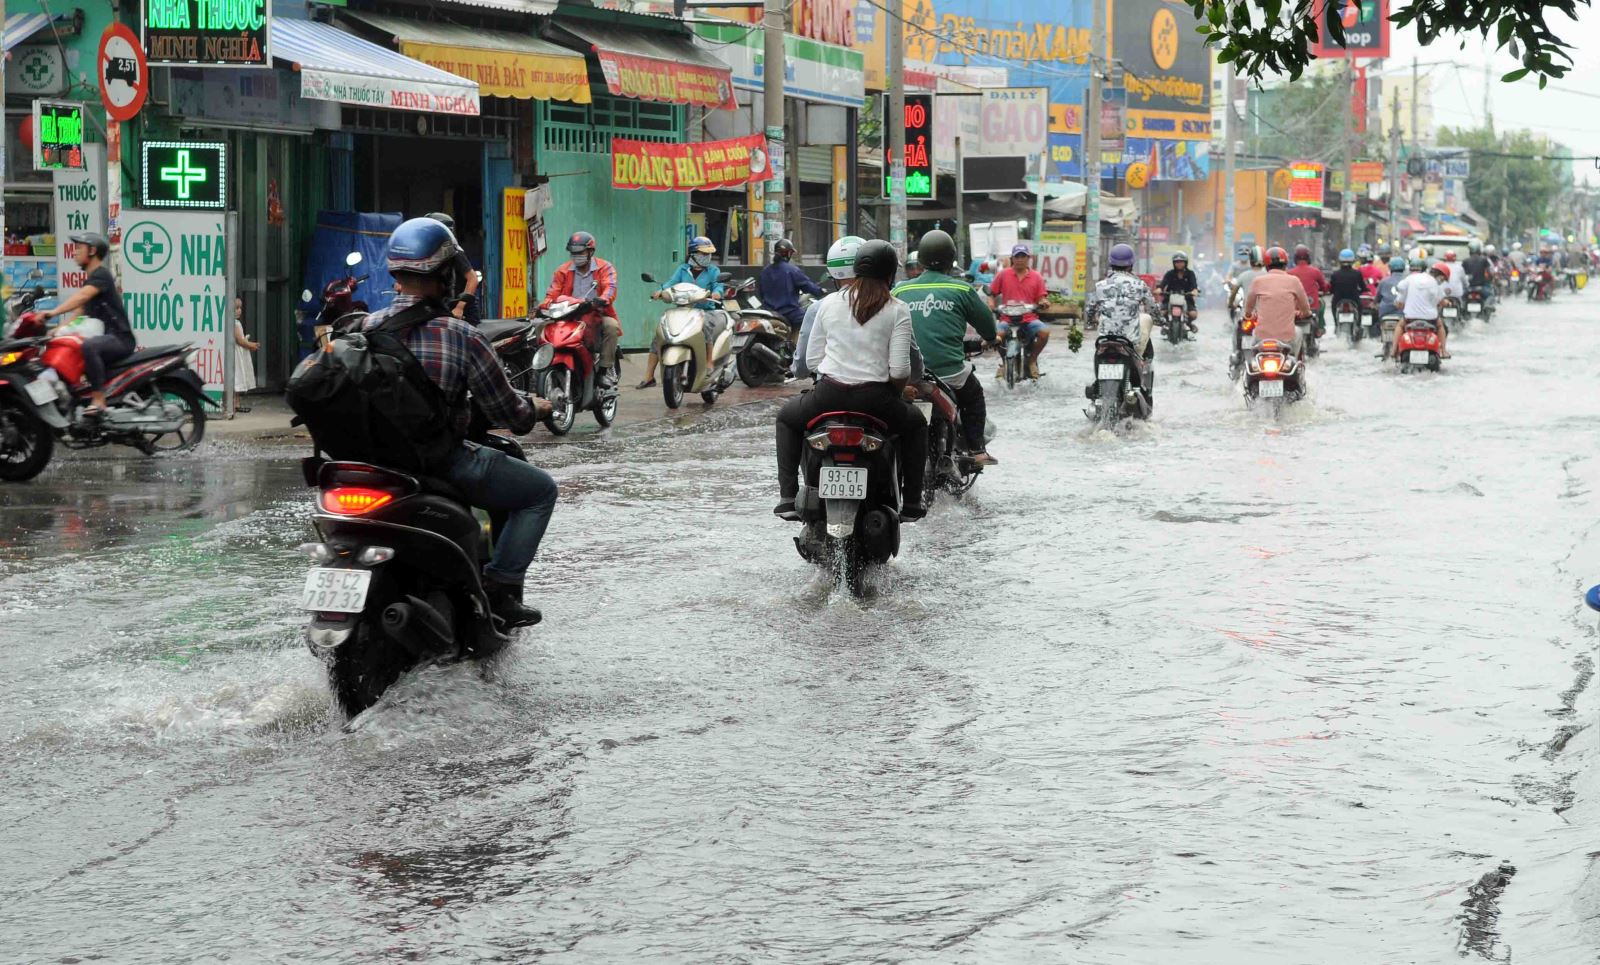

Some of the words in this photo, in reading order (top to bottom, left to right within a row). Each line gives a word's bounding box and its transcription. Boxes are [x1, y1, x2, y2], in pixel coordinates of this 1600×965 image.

[150, 35, 199, 60] MINH
[204, 32, 262, 60] NGHĨA
[118, 59, 136, 73] 2,5T
[477, 60, 500, 86] NHÀ
[503, 58, 527, 88] ĐẤT
[333, 82, 347, 99] NHÀ
[349, 84, 370, 102] THUỐC
[371, 88, 385, 104] TÂY
[390, 90, 430, 109] MINH
[433, 94, 478, 114] NGHĨA
[614, 146, 675, 187] HOÀNG
[674, 146, 707, 187] HẢI
[58, 179, 97, 201] THUỐC
[66, 213, 90, 231] TÂY
[181, 223, 225, 276] NHÀ
[506, 262, 524, 289] NHÀ
[124, 279, 184, 331] THUỐC
[190, 284, 225, 333] TÂY
[827, 470, 859, 483] 93-C1
[822, 484, 863, 497] 209.95
[316, 571, 361, 590] 59-C2
[306, 590, 362, 609] 787.32
